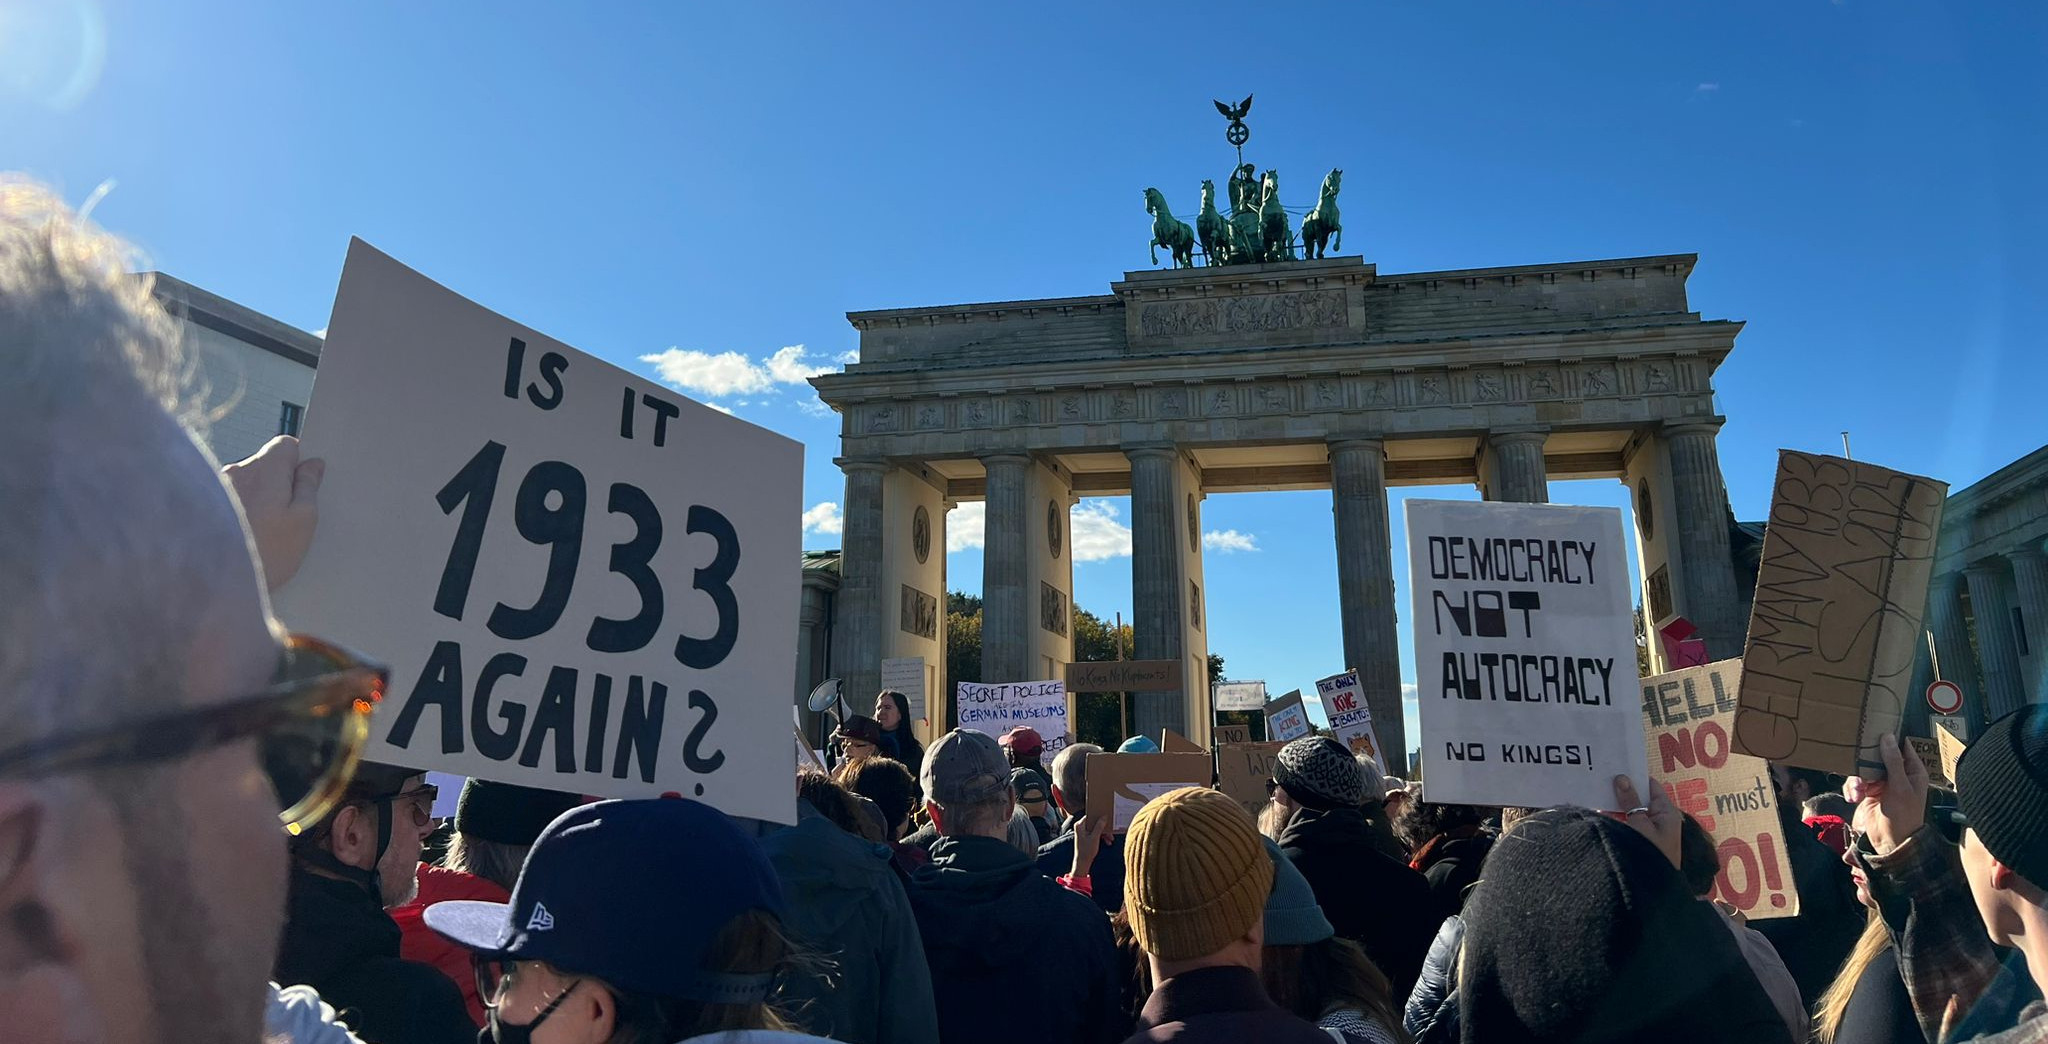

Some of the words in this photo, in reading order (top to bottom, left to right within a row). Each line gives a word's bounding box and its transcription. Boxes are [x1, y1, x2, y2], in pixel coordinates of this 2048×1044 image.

[504, 337, 569, 410] IS
[620, 386, 680, 447] IT
[1774, 452, 1850, 537] 1933
[1842, 465, 1940, 558] 2025
[435, 440, 741, 669] 1933
[1428, 536, 1596, 584] DEMOCRACY
[1433, 590, 1540, 638] NOT
[1736, 527, 1830, 760] GERMANY
[1801, 556, 1935, 749] USA
[960, 684, 1008, 703] SECRET
[1013, 683, 1063, 698] POLICE
[1320, 682, 1333, 693] THE
[1335, 675, 1357, 689] ONLY
[1332, 691, 1357, 712] KING
[1442, 652, 1614, 706] AUTOCRACY
[386, 640, 725, 796] AGAIN?
[961, 708, 1008, 723] GERMAN
[1012, 706, 1065, 720] MUSEUMS
[1225, 730, 1243, 742] NO
[1278, 714, 1300, 733] KING
[1329, 717, 1339, 728] I
[1341, 714, 1357, 725] BOW
[1446, 742, 1486, 762] NO
[1501, 744, 1593, 770] KINGS!
[1658, 720, 1729, 774] NO
[1715, 776, 1770, 816] must
[1709, 832, 1787, 911] O!
